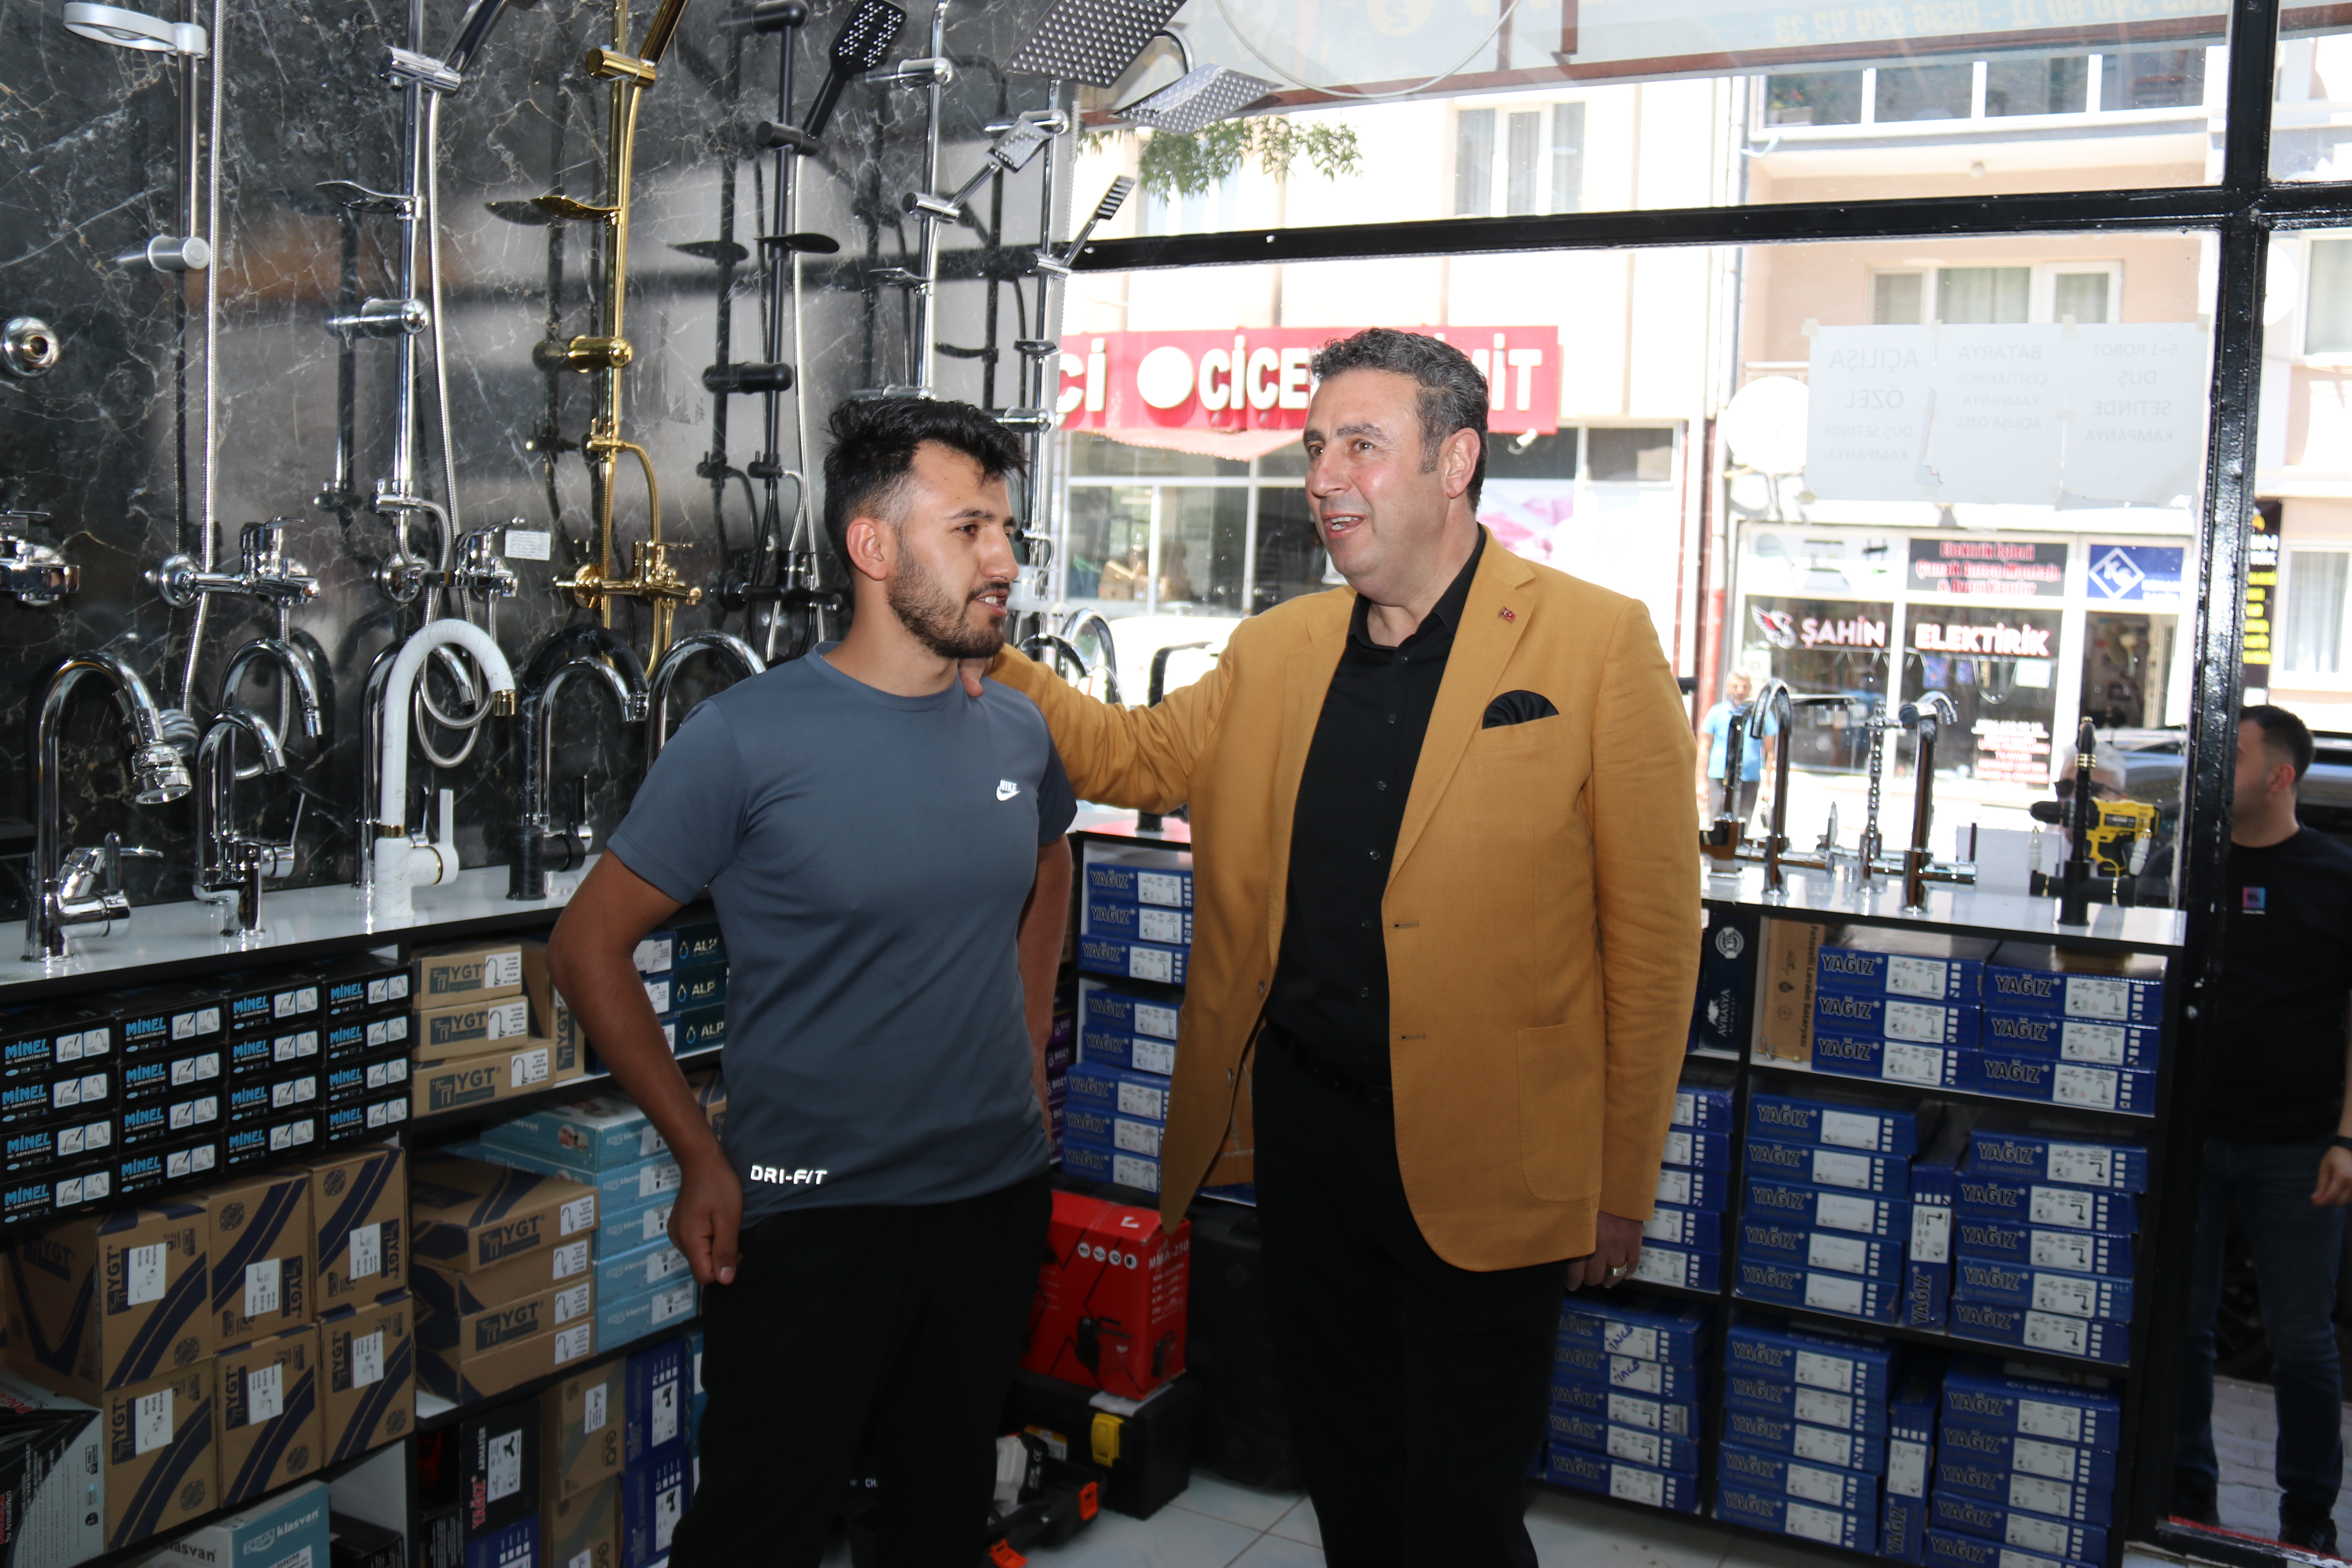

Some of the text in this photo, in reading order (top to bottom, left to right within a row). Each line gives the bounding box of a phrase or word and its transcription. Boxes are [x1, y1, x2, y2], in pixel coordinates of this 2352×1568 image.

[1801, 615, 2052, 656] ŞAHİN ELEKTİRİK
[999, 779, 1017, 793] NIKE
[1090, 870, 1128, 888] YAĞIZ
[1091, 906, 1129, 924] YAĞIZ
[1081, 942, 1120, 962] YAĞIZ
[1822, 952, 1876, 976] YAĞIZ
[451, 964, 483, 980] YGT
[1804, 967, 1815, 1001] Lavabo
[330, 983, 363, 1000] MİNEL
[691, 981, 715, 996] ALP
[1995, 973, 2053, 998] YAĞIZ
[233, 996, 269, 1013] MİNEL
[1088, 998, 1125, 1018] YAĞIZ
[1717, 988, 1731, 1038] AVRASYA
[1818, 995, 1872, 1020] YAĞIZ
[126, 1017, 166, 1037] MİNEL
[452, 1011, 488, 1029] YGT
[557, 1006, 568, 1047] YGT
[701, 1022, 725, 1037] ALP
[1800, 1004, 1811, 1047] Bataryası
[1992, 1017, 2049, 1042] YAĞIZ
[330, 1025, 362, 1043] MİNEL
[1085, 1033, 1122, 1053] YAĞIZ
[5, 1038, 49, 1060] MİNEL
[233, 1040, 269, 1058] MİNEL
[1818, 1036, 1872, 1062] YAĞIZ
[126, 1063, 165, 1082] MİNEL
[330, 1067, 362, 1085] MİNEL
[455, 1067, 495, 1092] YGT
[1984, 1059, 2042, 1084] YAĞIZ
[2, 1083, 46, 1104] MİNEL
[231, 1085, 267, 1104] MİNEL
[1069, 1077, 1107, 1096] YAĞIZ
[125, 1107, 163, 1127] MİNEL
[330, 1108, 363, 1125] MİNEL
[1065, 1113, 1104, 1133] YAĞIZ
[1757, 1104, 1809, 1128] YAĞIZ
[7, 1132, 51, 1154] MİNEL
[229, 1129, 265, 1148] MİNEL
[1064, 1149, 1104, 1169] YAĞIZ
[1749, 1144, 1801, 1168] YAĞIZ
[1977, 1141, 2034, 1165] YAĞIZ
[121, 1156, 161, 1176] MİNEL
[750, 1164, 827, 1185] DRI-FIT
[5, 1185, 49, 1207] MİNEL
[1752, 1187, 1804, 1210] YAĞIZ
[1961, 1183, 2016, 1207] YAĞIZ
[503, 1216, 540, 1241] YGT
[1745, 1227, 1797, 1250] YAĞIZ
[1962, 1225, 2017, 1249] YAĞIZ
[42, 1237, 71, 1266] YGT
[388, 1240, 399, 1277] YGT
[108, 1252, 120, 1290] YGT
[1742, 1266, 1794, 1290] YAĞIZ
[1964, 1266, 2020, 1290] YAĞIZ
[290, 1278, 302, 1316] YGT
[1911, 1275, 1932, 1324] YAĞIZ
[500, 1302, 539, 1327] YGT
[1559, 1314, 1593, 1337] AĞIZ
[1958, 1306, 2011, 1330] YAĞIZ
[333, 1337, 342, 1368] YGT
[1554, 1347, 1599, 1370] YAĞIZ
[1732, 1342, 1784, 1366] YAĞIZ
[227, 1371, 238, 1406] YGT
[1552, 1386, 1597, 1408] YAĞIZ
[1732, 1379, 1784, 1403] YAĞIZ
[1948, 1392, 2005, 1416] YAĞIZ
[113, 1401, 125, 1436] YGT
[1550, 1416, 1596, 1439] YAĞIZ
[1732, 1416, 1783, 1439] YAĞIZ
[1944, 1429, 2000, 1453] YAĞIZ
[1553, 1455, 1600, 1479] YAĞIZ
[1725, 1454, 1775, 1478] YAĞIZ
[1941, 1465, 1996, 1490] YAĞIZ
[470, 1479, 486, 1530] YAĞIZ
[1724, 1491, 1774, 1516] YAĞIZ
[1938, 1501, 1993, 1527] YAĞIZ
[276, 1510, 318, 1537] klasvan
[1886, 1507, 1907, 1554] YAĞIZ
[5, 1533, 11, 1543] Su
[1931, 1537, 1986, 1563] YAĞIZ
